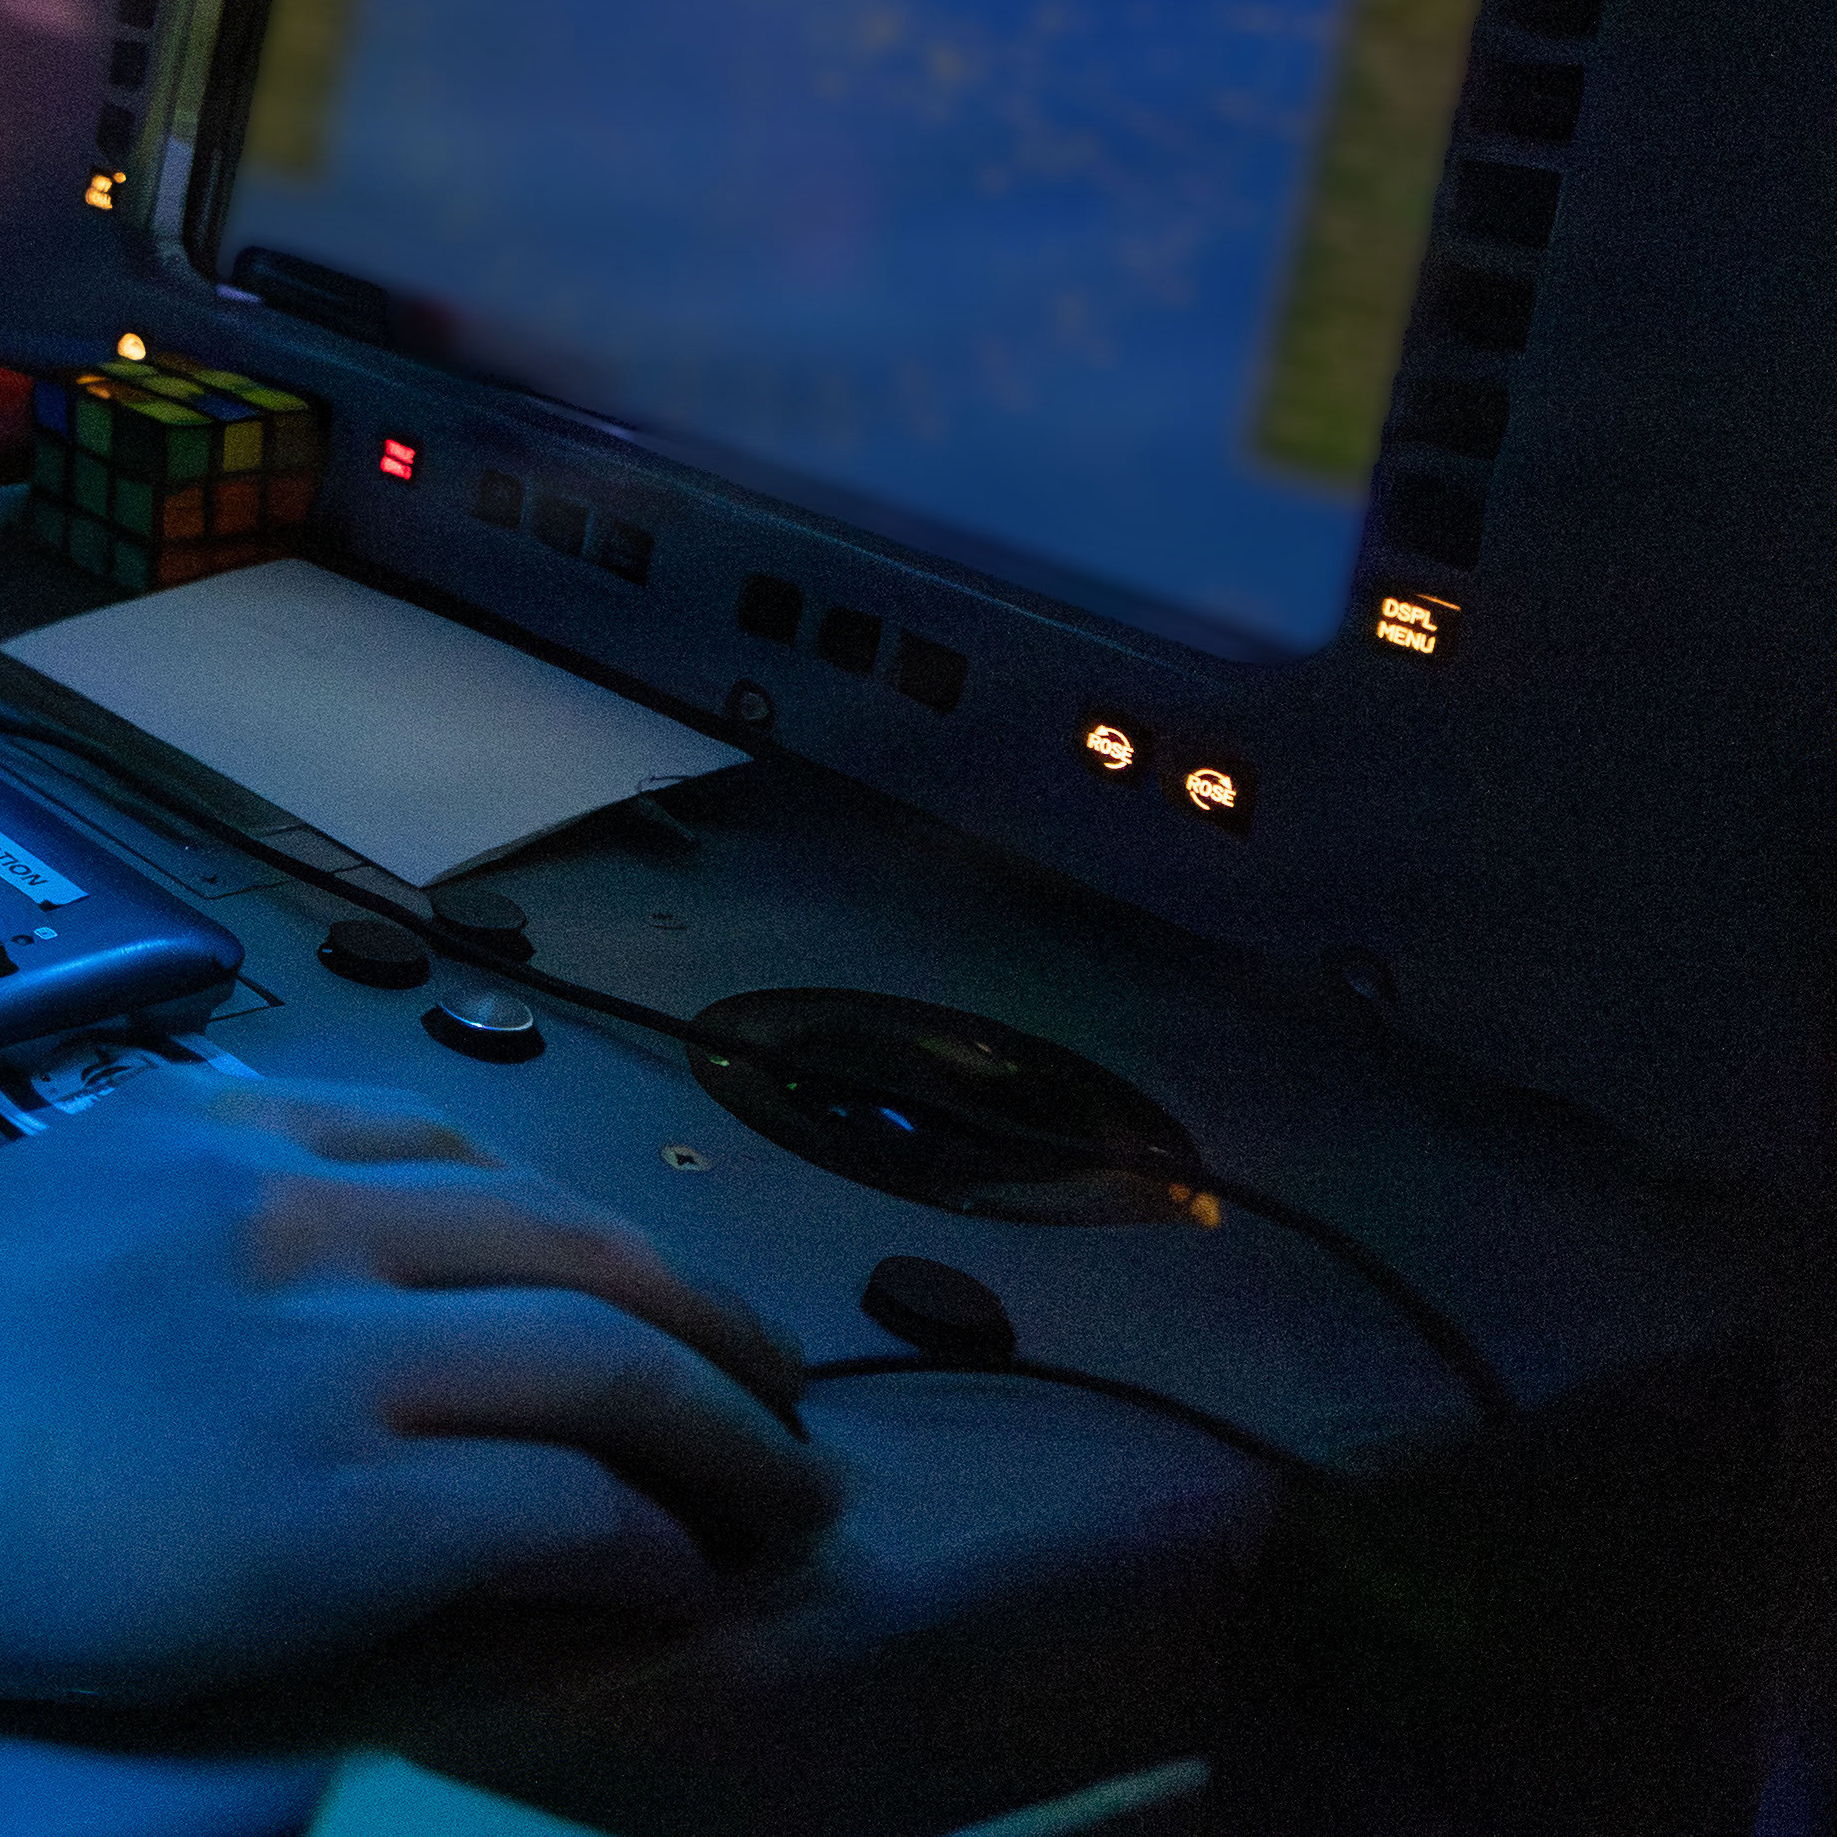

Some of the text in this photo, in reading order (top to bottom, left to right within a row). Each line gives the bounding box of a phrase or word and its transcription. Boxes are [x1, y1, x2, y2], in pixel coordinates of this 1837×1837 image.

[1382, 597, 1438, 632] DSPL
[1376, 620, 1436, 654] MENU
[1086, 732, 1135, 765] ROSE
[1185, 774, 1237, 808] ROSE
